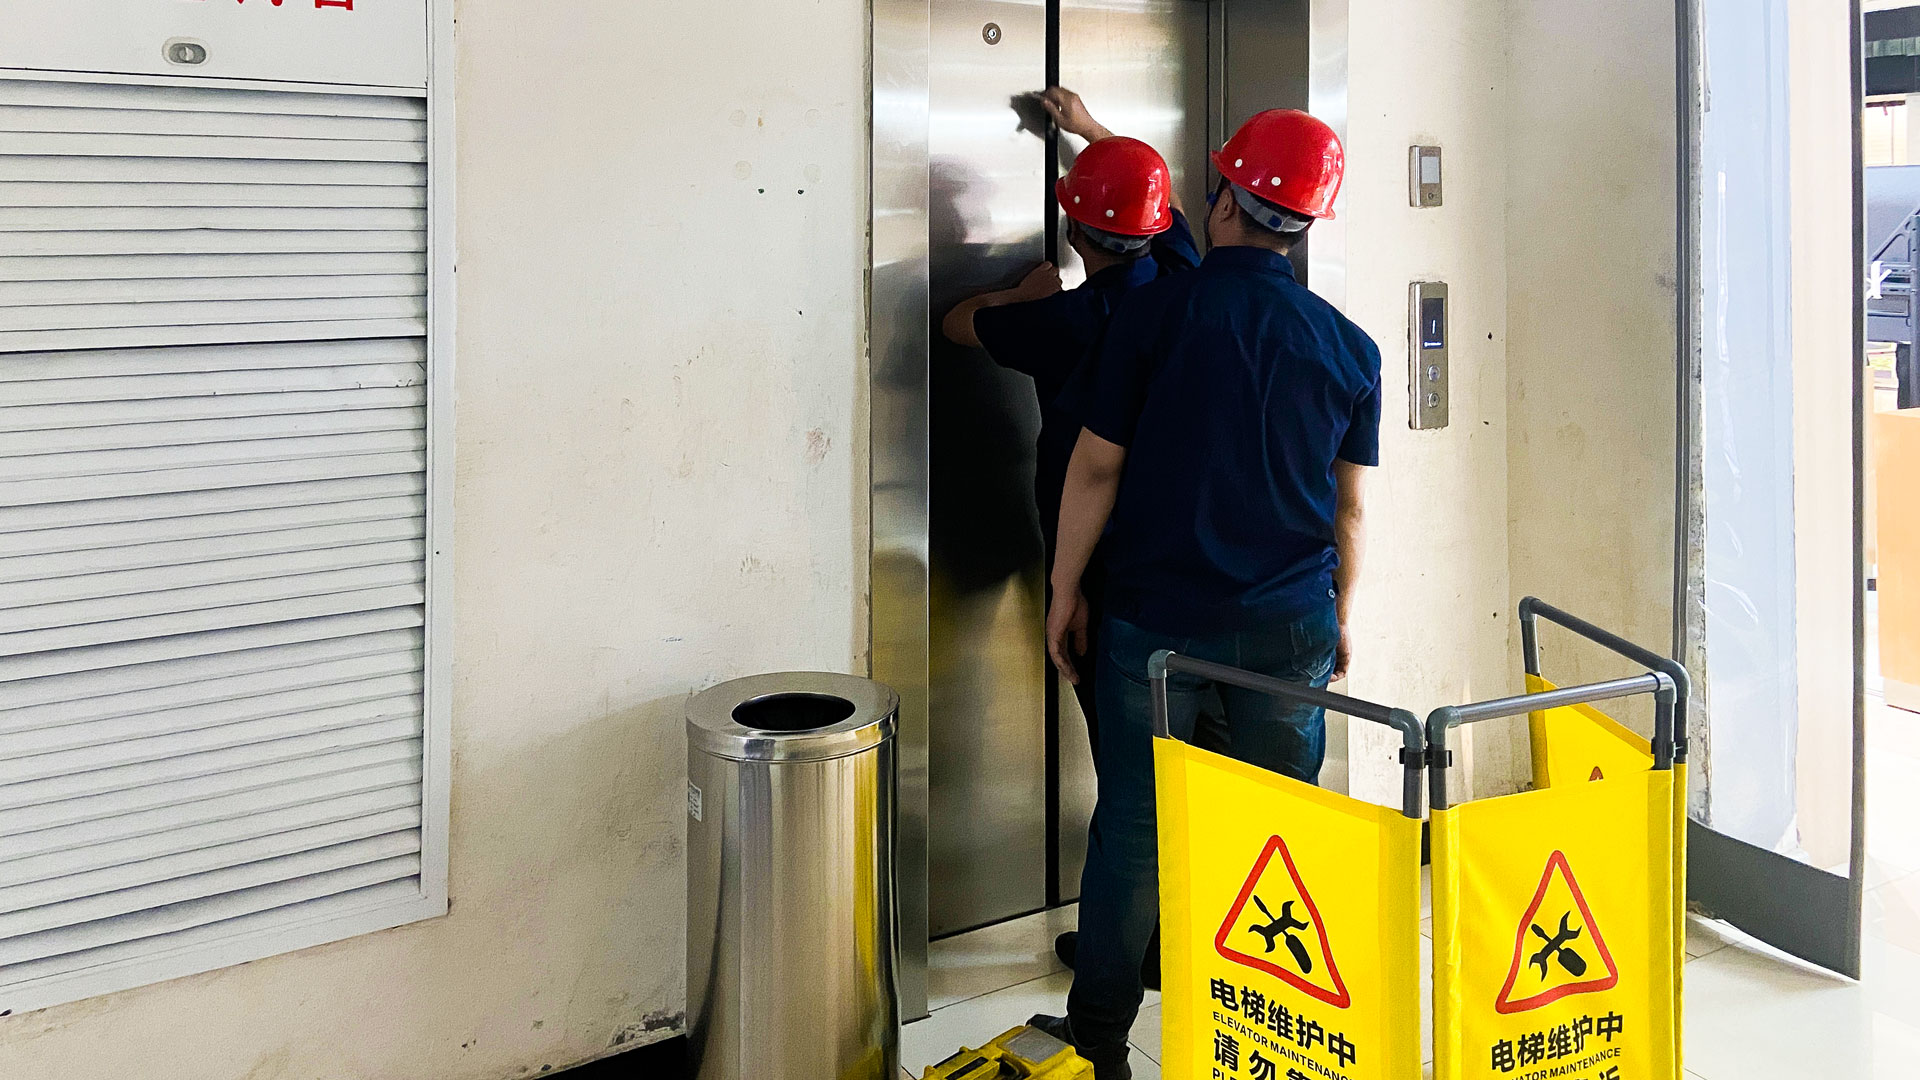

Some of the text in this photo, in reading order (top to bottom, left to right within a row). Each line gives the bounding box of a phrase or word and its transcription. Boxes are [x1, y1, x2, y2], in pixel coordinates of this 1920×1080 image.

[1210, 977, 1356, 1068] 电梯维护中
[1212, 1010, 1352, 1080] ELEVATOR MAINTENAN
[1491, 1010, 1623, 1073] 电梯维护中
[1549, 1047, 1621, 1078] MAINTENANCE
